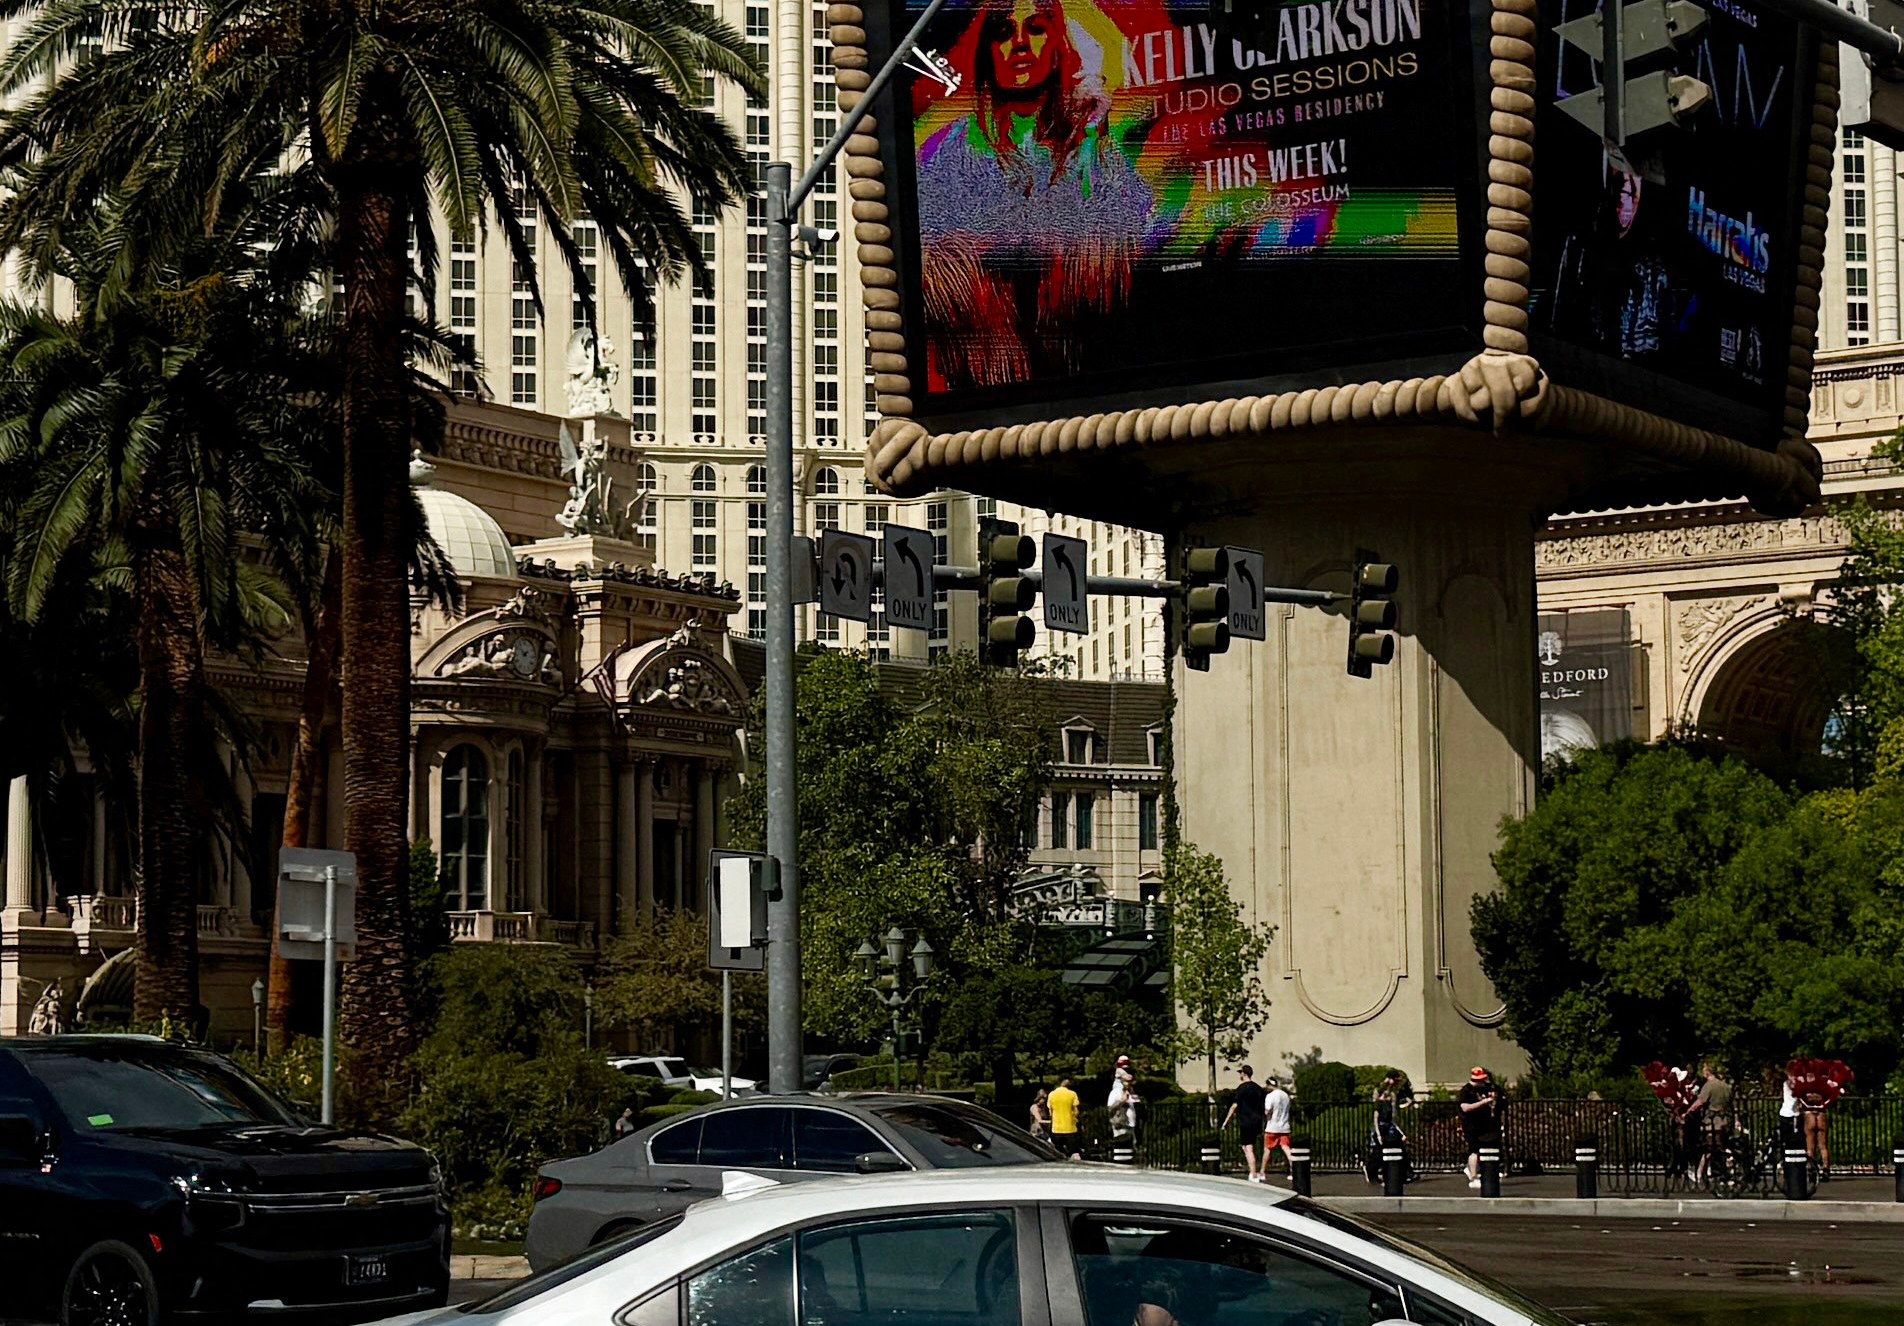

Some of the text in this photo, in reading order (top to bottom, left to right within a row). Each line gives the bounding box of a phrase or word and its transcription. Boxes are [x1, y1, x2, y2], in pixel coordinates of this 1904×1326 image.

[1731, 3, 1759, 28] VEGAS
[1122, 23, 1217, 90] KELLY
[1148, 52, 1419, 119] TUDIO SESSIONS
[1163, 91, 1386, 143] THE LAS VEGAS RESIDENCY
[1203, 138, 1348, 193] THIS WEEK!
[1241, 183, 1351, 214] COLOSSEUM
[892, 597, 928, 622] ONLY
[1049, 603, 1081, 626] ONLY
[1233, 611, 1261, 633] ONLY
[1540, 667, 1609, 684] EDFORD
